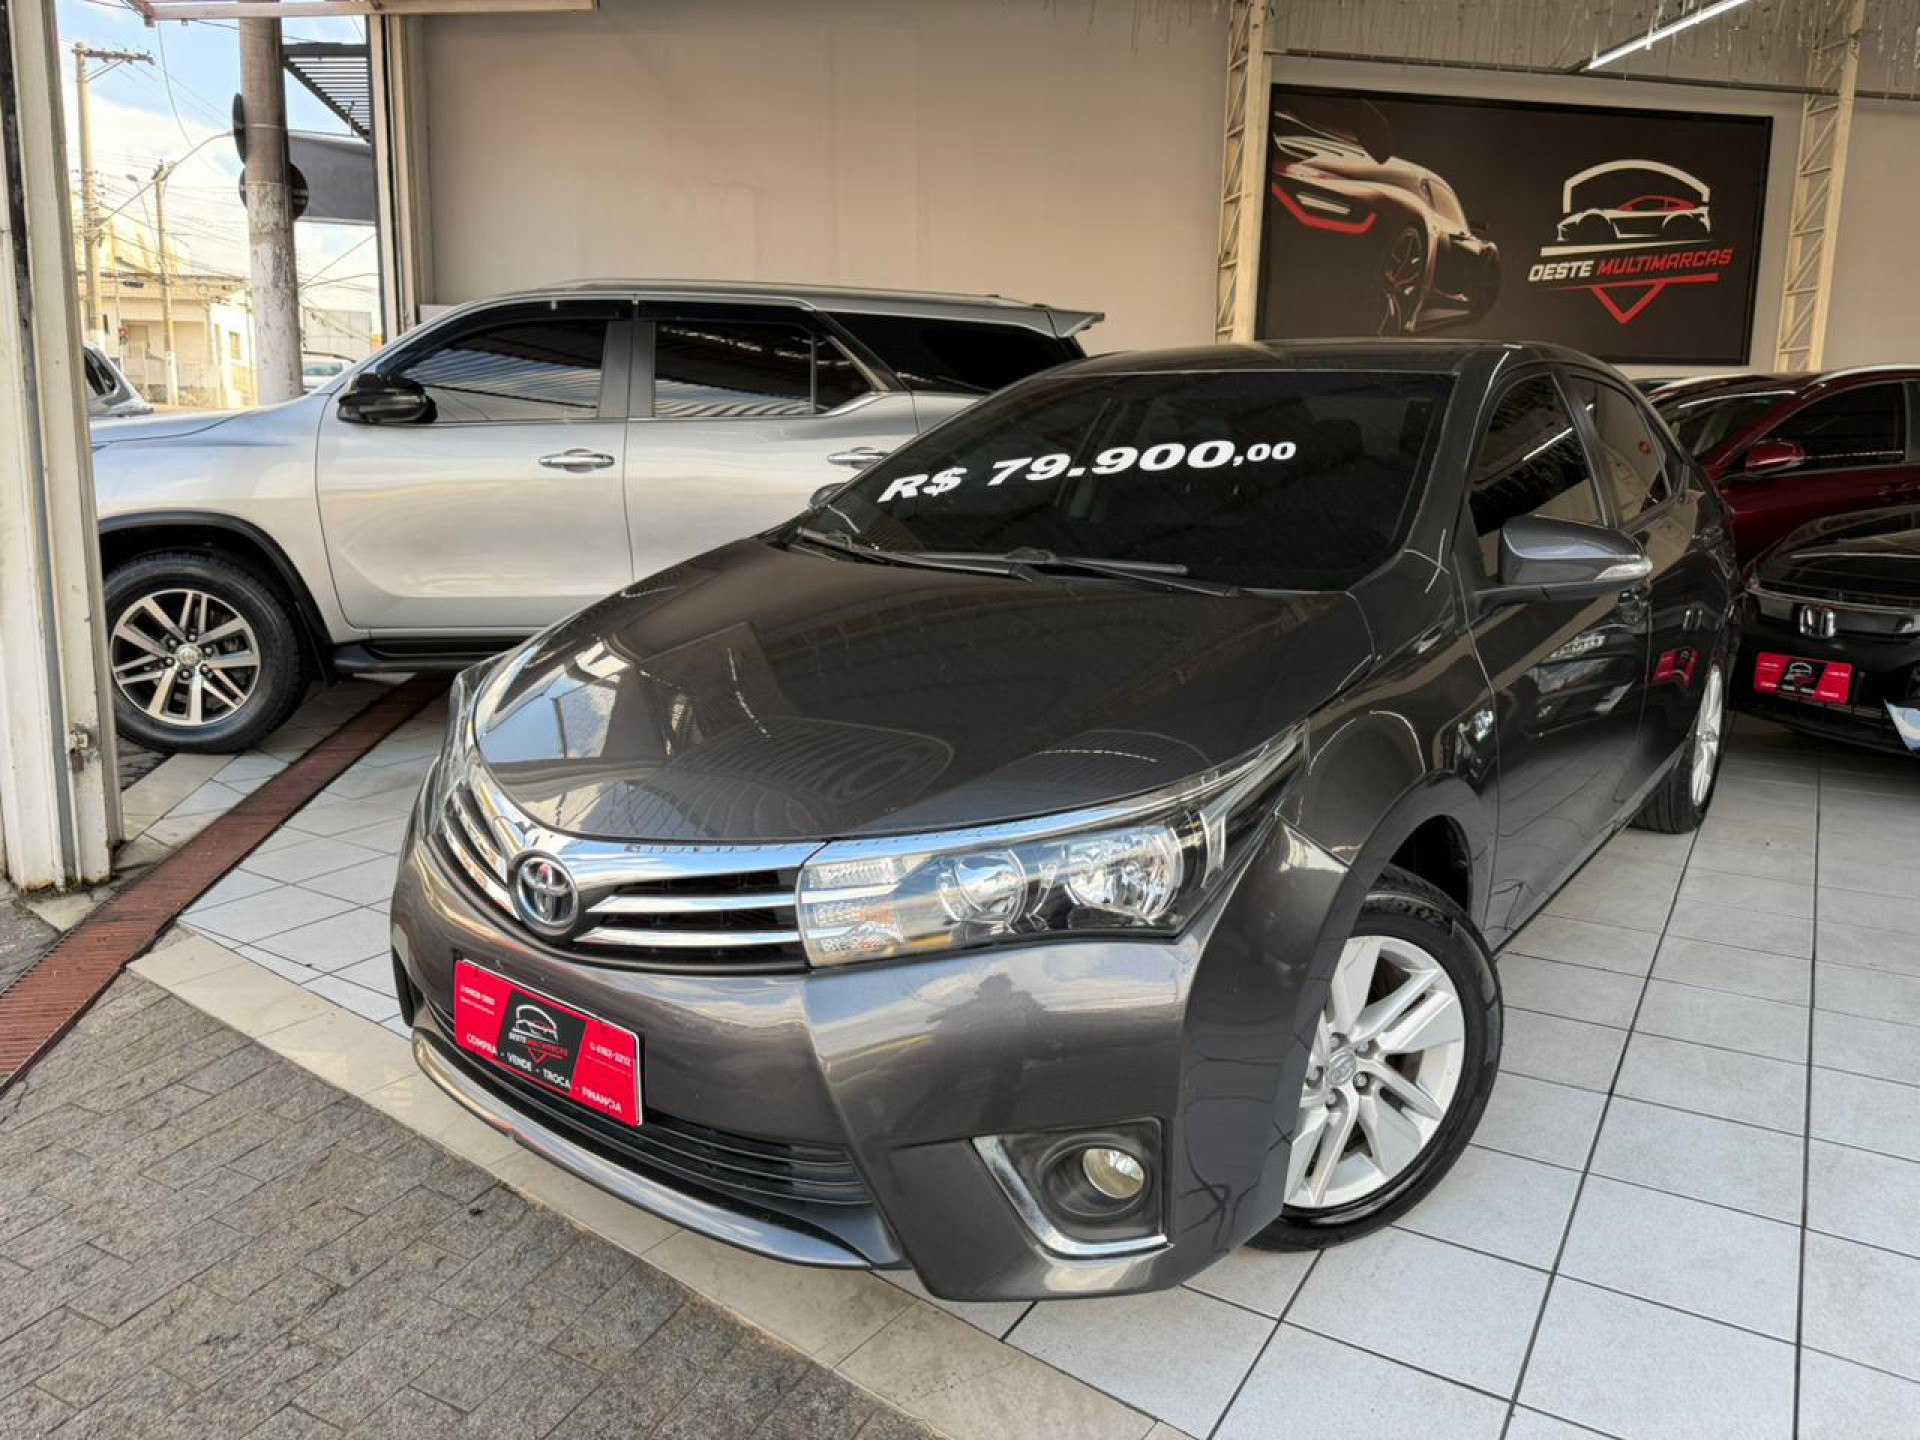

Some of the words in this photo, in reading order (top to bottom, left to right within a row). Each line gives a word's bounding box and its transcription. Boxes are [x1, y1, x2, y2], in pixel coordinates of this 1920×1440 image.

[1528, 260, 1594, 282] OESTE
[1596, 248, 1735, 277] MULTIMARCAS
[877, 466, 968, 503] R$
[987, 440, 1297, 487] 79.900,00
[543, 1068, 571, 1089] TROCA
